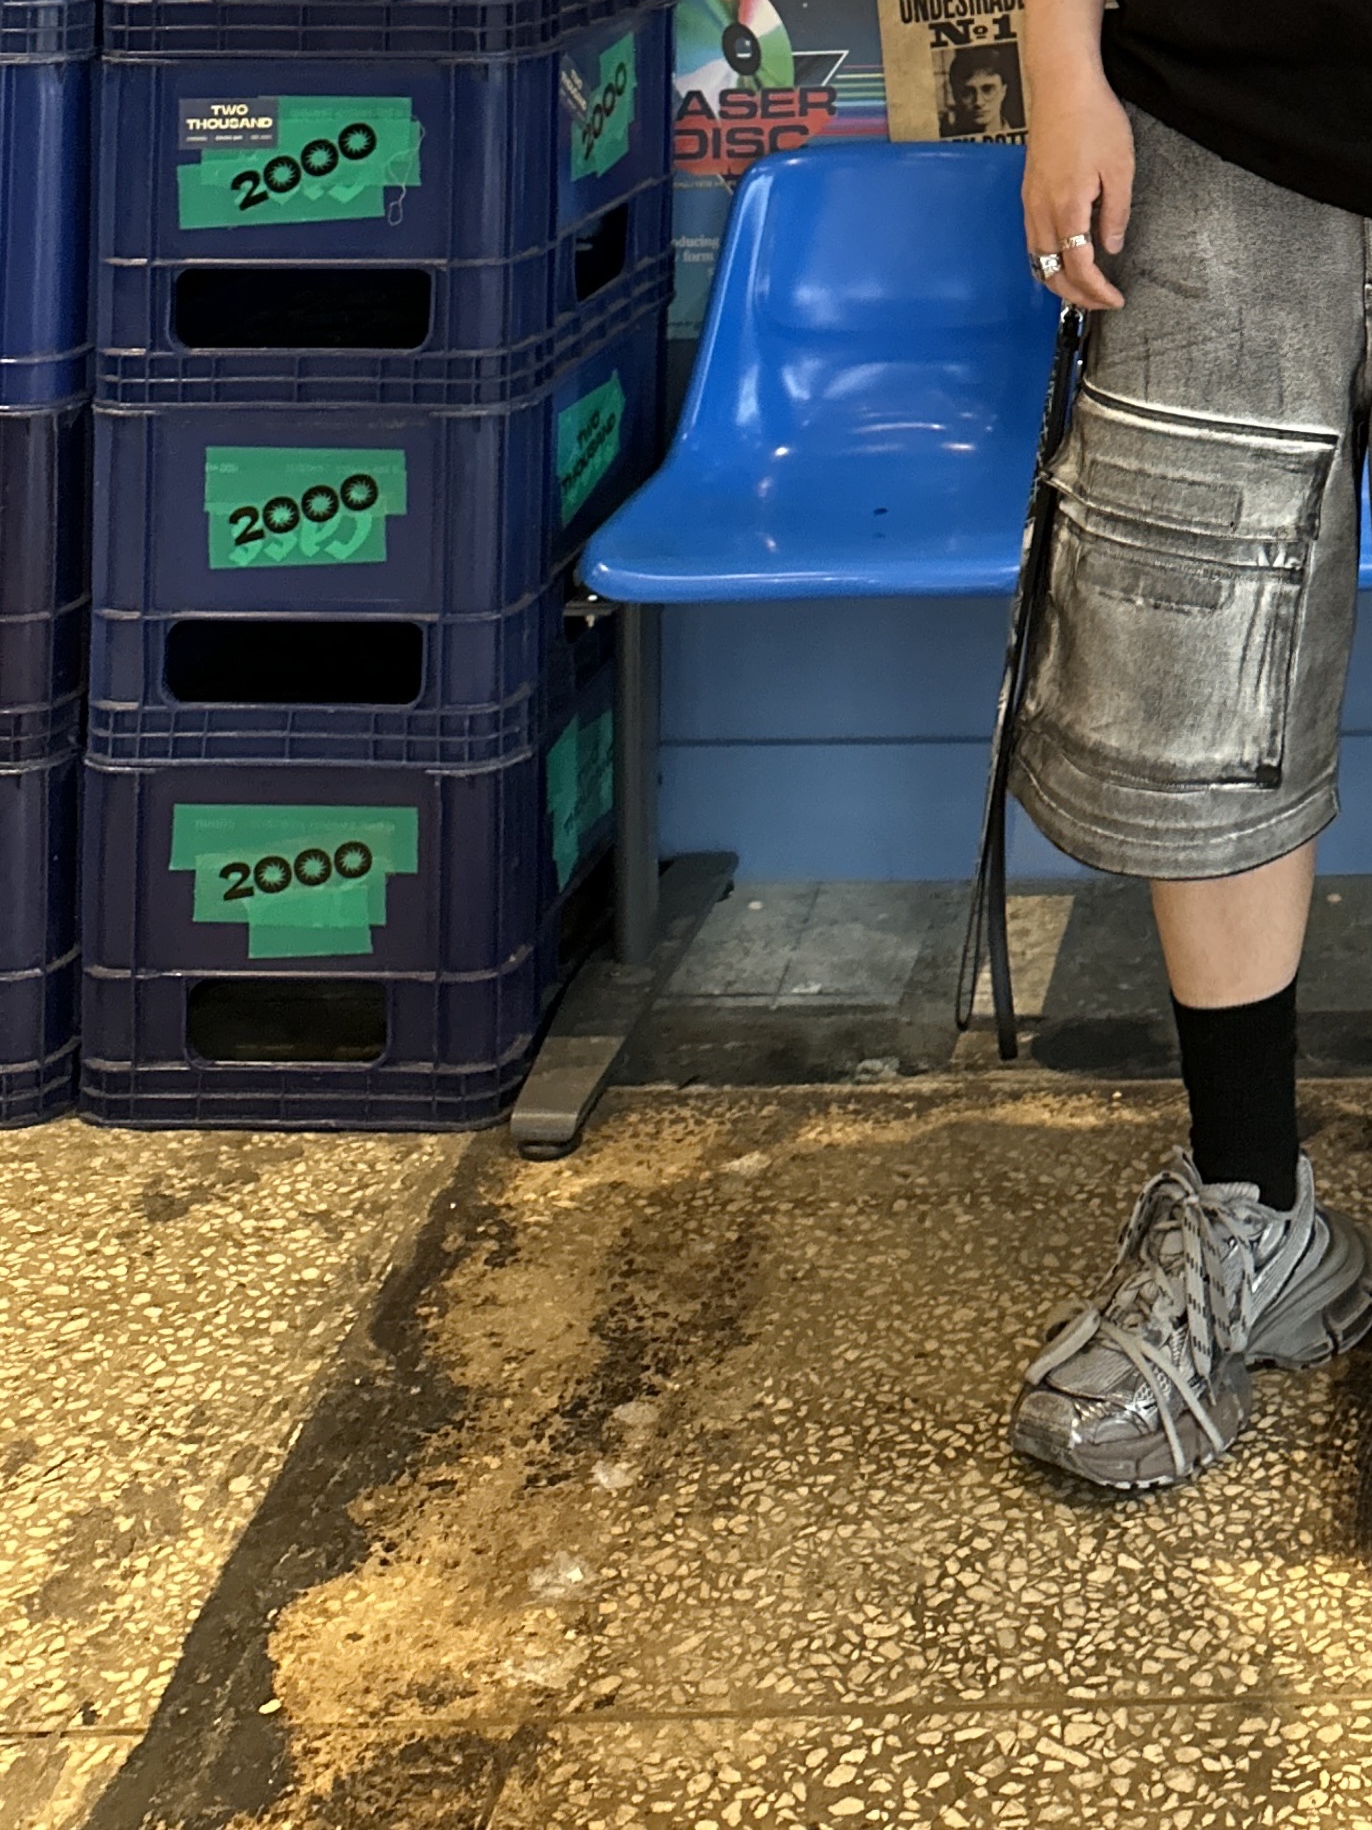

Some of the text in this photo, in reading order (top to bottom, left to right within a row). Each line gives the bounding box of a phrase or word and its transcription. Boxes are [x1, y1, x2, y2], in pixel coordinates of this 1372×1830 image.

[185, 117, 273, 131] THOUSAND
[210, 104, 248, 116] TWO
[676, 86, 838, 121] ASER
[230, 122, 378, 211] 2000
[228, 473, 379, 546] 2000
[218, 840, 373, 901] 2000
